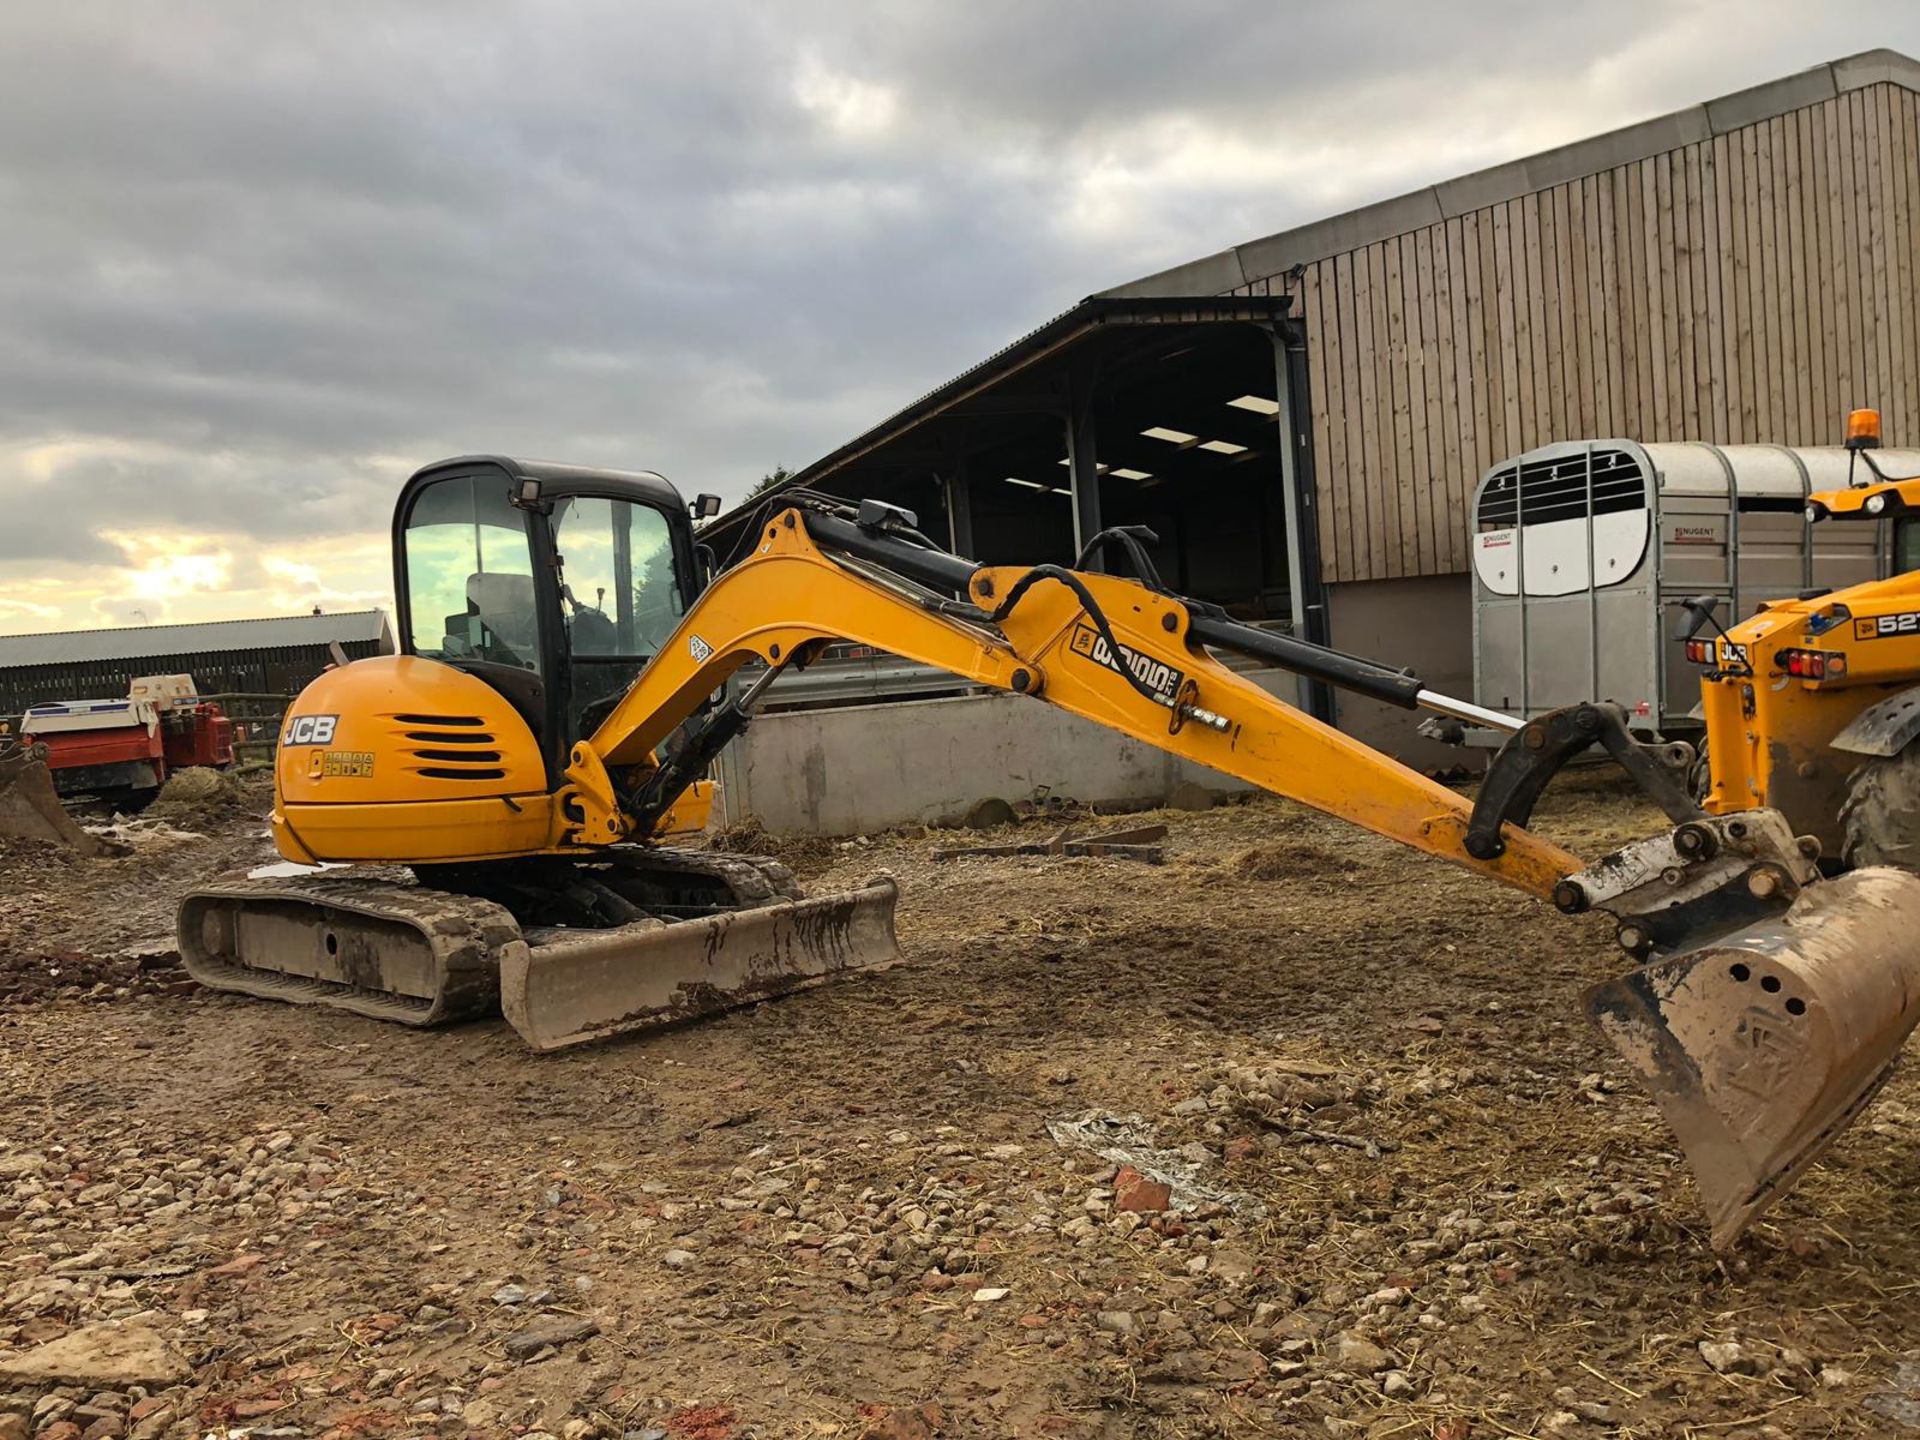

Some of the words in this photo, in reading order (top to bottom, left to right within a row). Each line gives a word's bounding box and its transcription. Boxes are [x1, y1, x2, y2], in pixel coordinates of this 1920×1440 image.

[1683, 527, 1714, 536] NUGENT
[1878, 613, 1920, 633] 52
[284, 716, 336, 745] JCB
